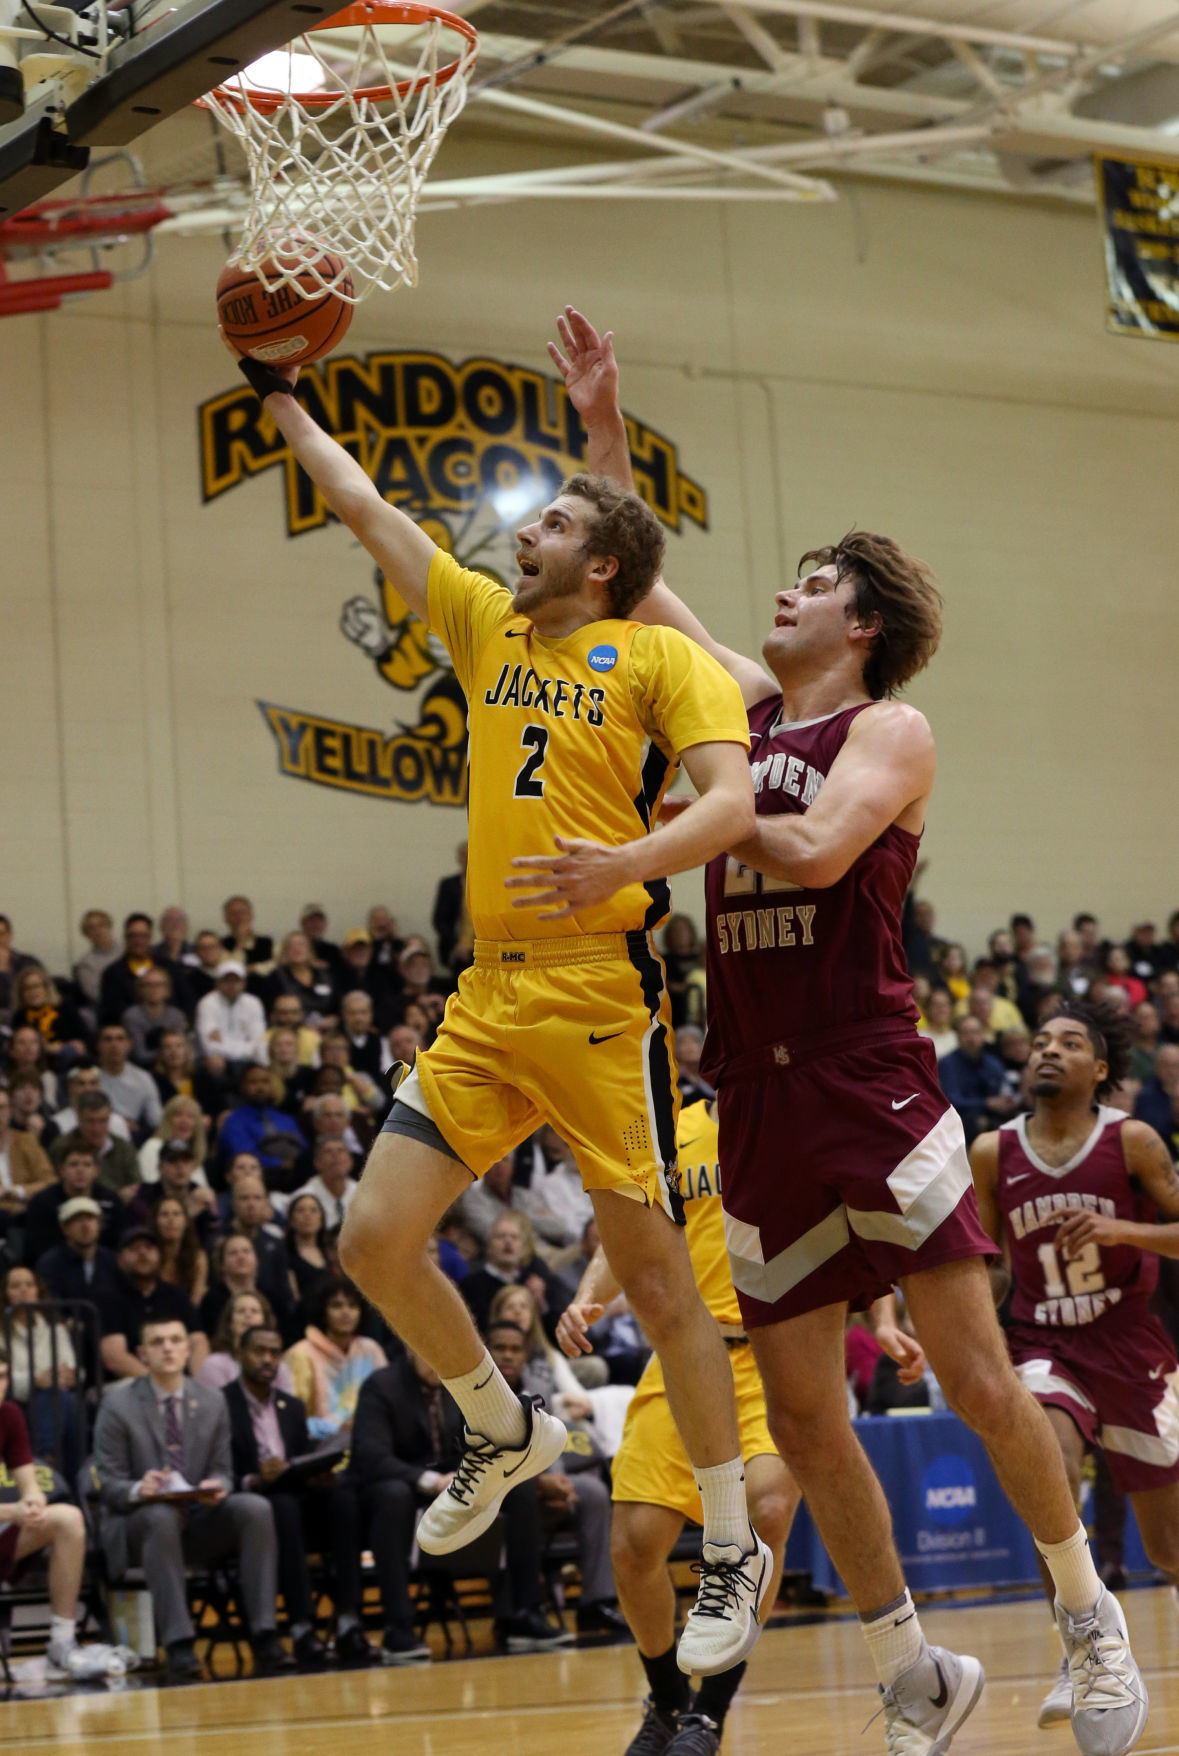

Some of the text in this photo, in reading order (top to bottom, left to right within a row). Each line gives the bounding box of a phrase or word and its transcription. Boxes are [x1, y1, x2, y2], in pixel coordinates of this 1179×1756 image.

[590, 655, 616, 665] NCAA
[484, 662, 606, 728] JACKETS
[275, 712, 468, 800] YELLOW
[512, 723, 549, 800] 2
[716, 904, 817, 955] SYDNEY
[1037, 1240, 1106, 1298] 12
[925, 1485, 977, 1510] NCAA
